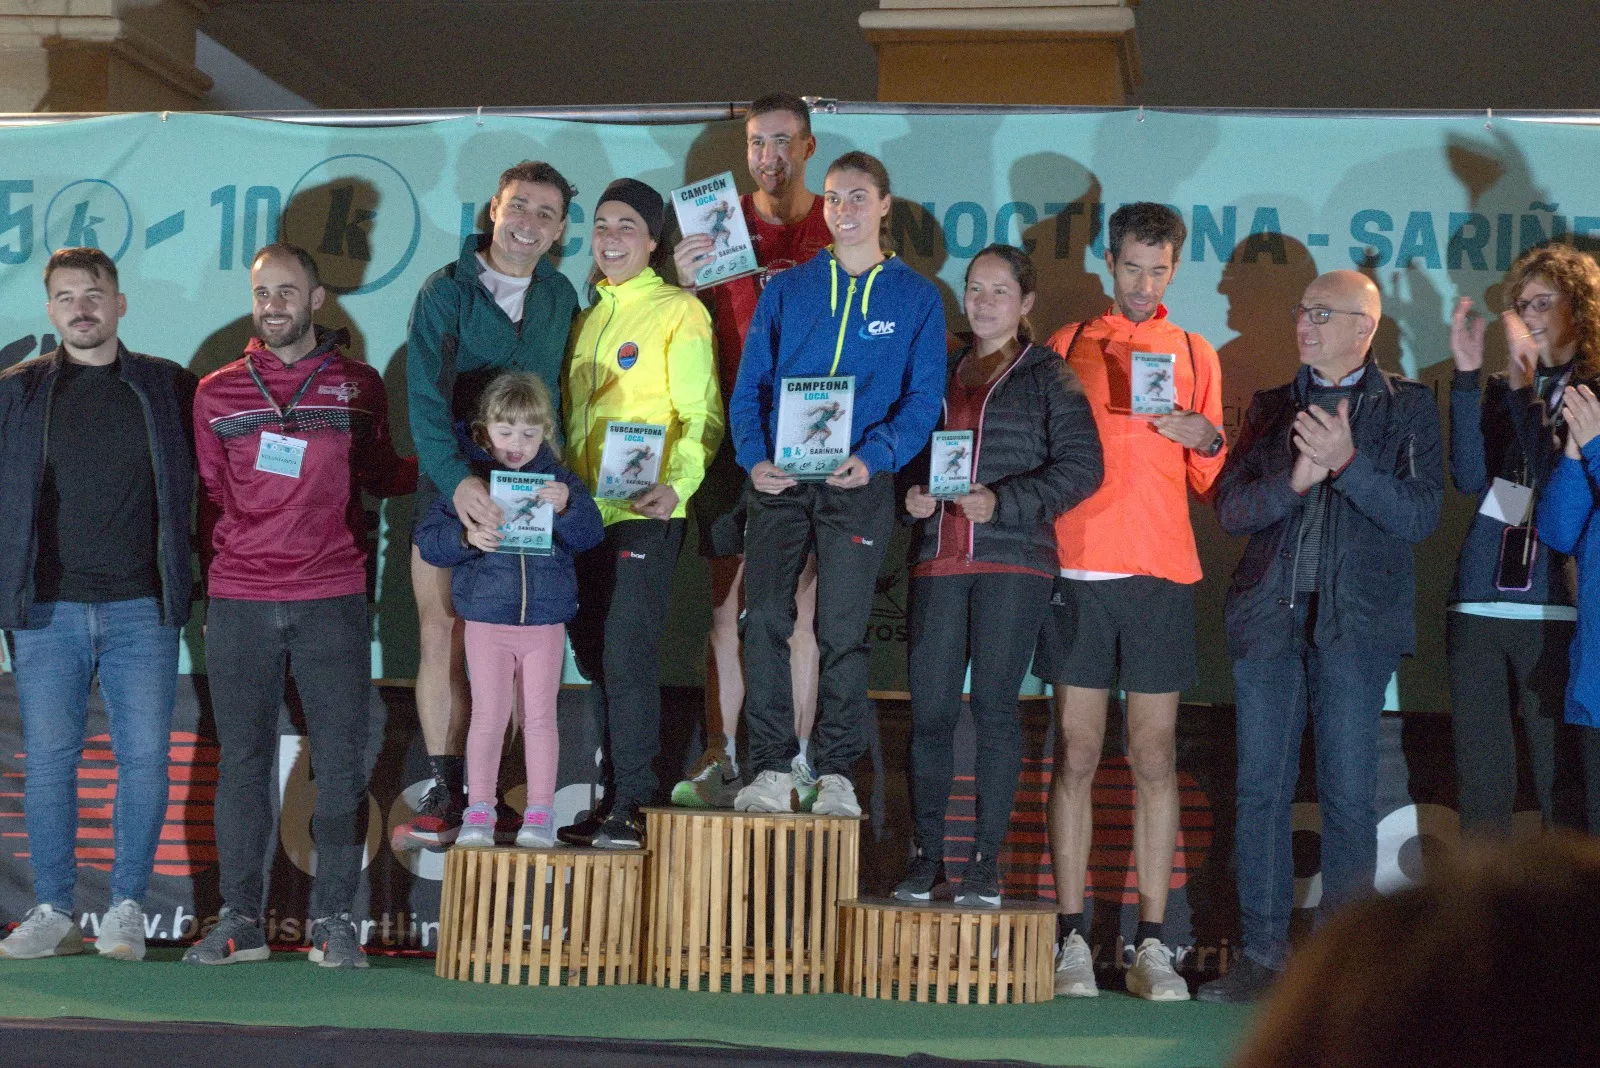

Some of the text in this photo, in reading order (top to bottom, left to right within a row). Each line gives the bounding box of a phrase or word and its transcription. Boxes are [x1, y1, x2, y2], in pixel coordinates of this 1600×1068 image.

[681, 179, 727, 201] CAMPEÓN
[695, 194, 718, 207] LOCAL
[211, 185, 281, 270] 10
[890, 202, 1288, 264] NOCTUNA
[787, 380, 849, 392] CAMPEONA
[804, 392, 830, 401] LOCAL
[609, 425, 663, 436] SUBCAMPEONA
[624, 434, 645, 443] LOCAL
[809, 447, 844, 455] SARIÑENA
[496, 475, 547, 486] SUBCAMPEÓ
[511, 484, 533, 492] LOCAL
